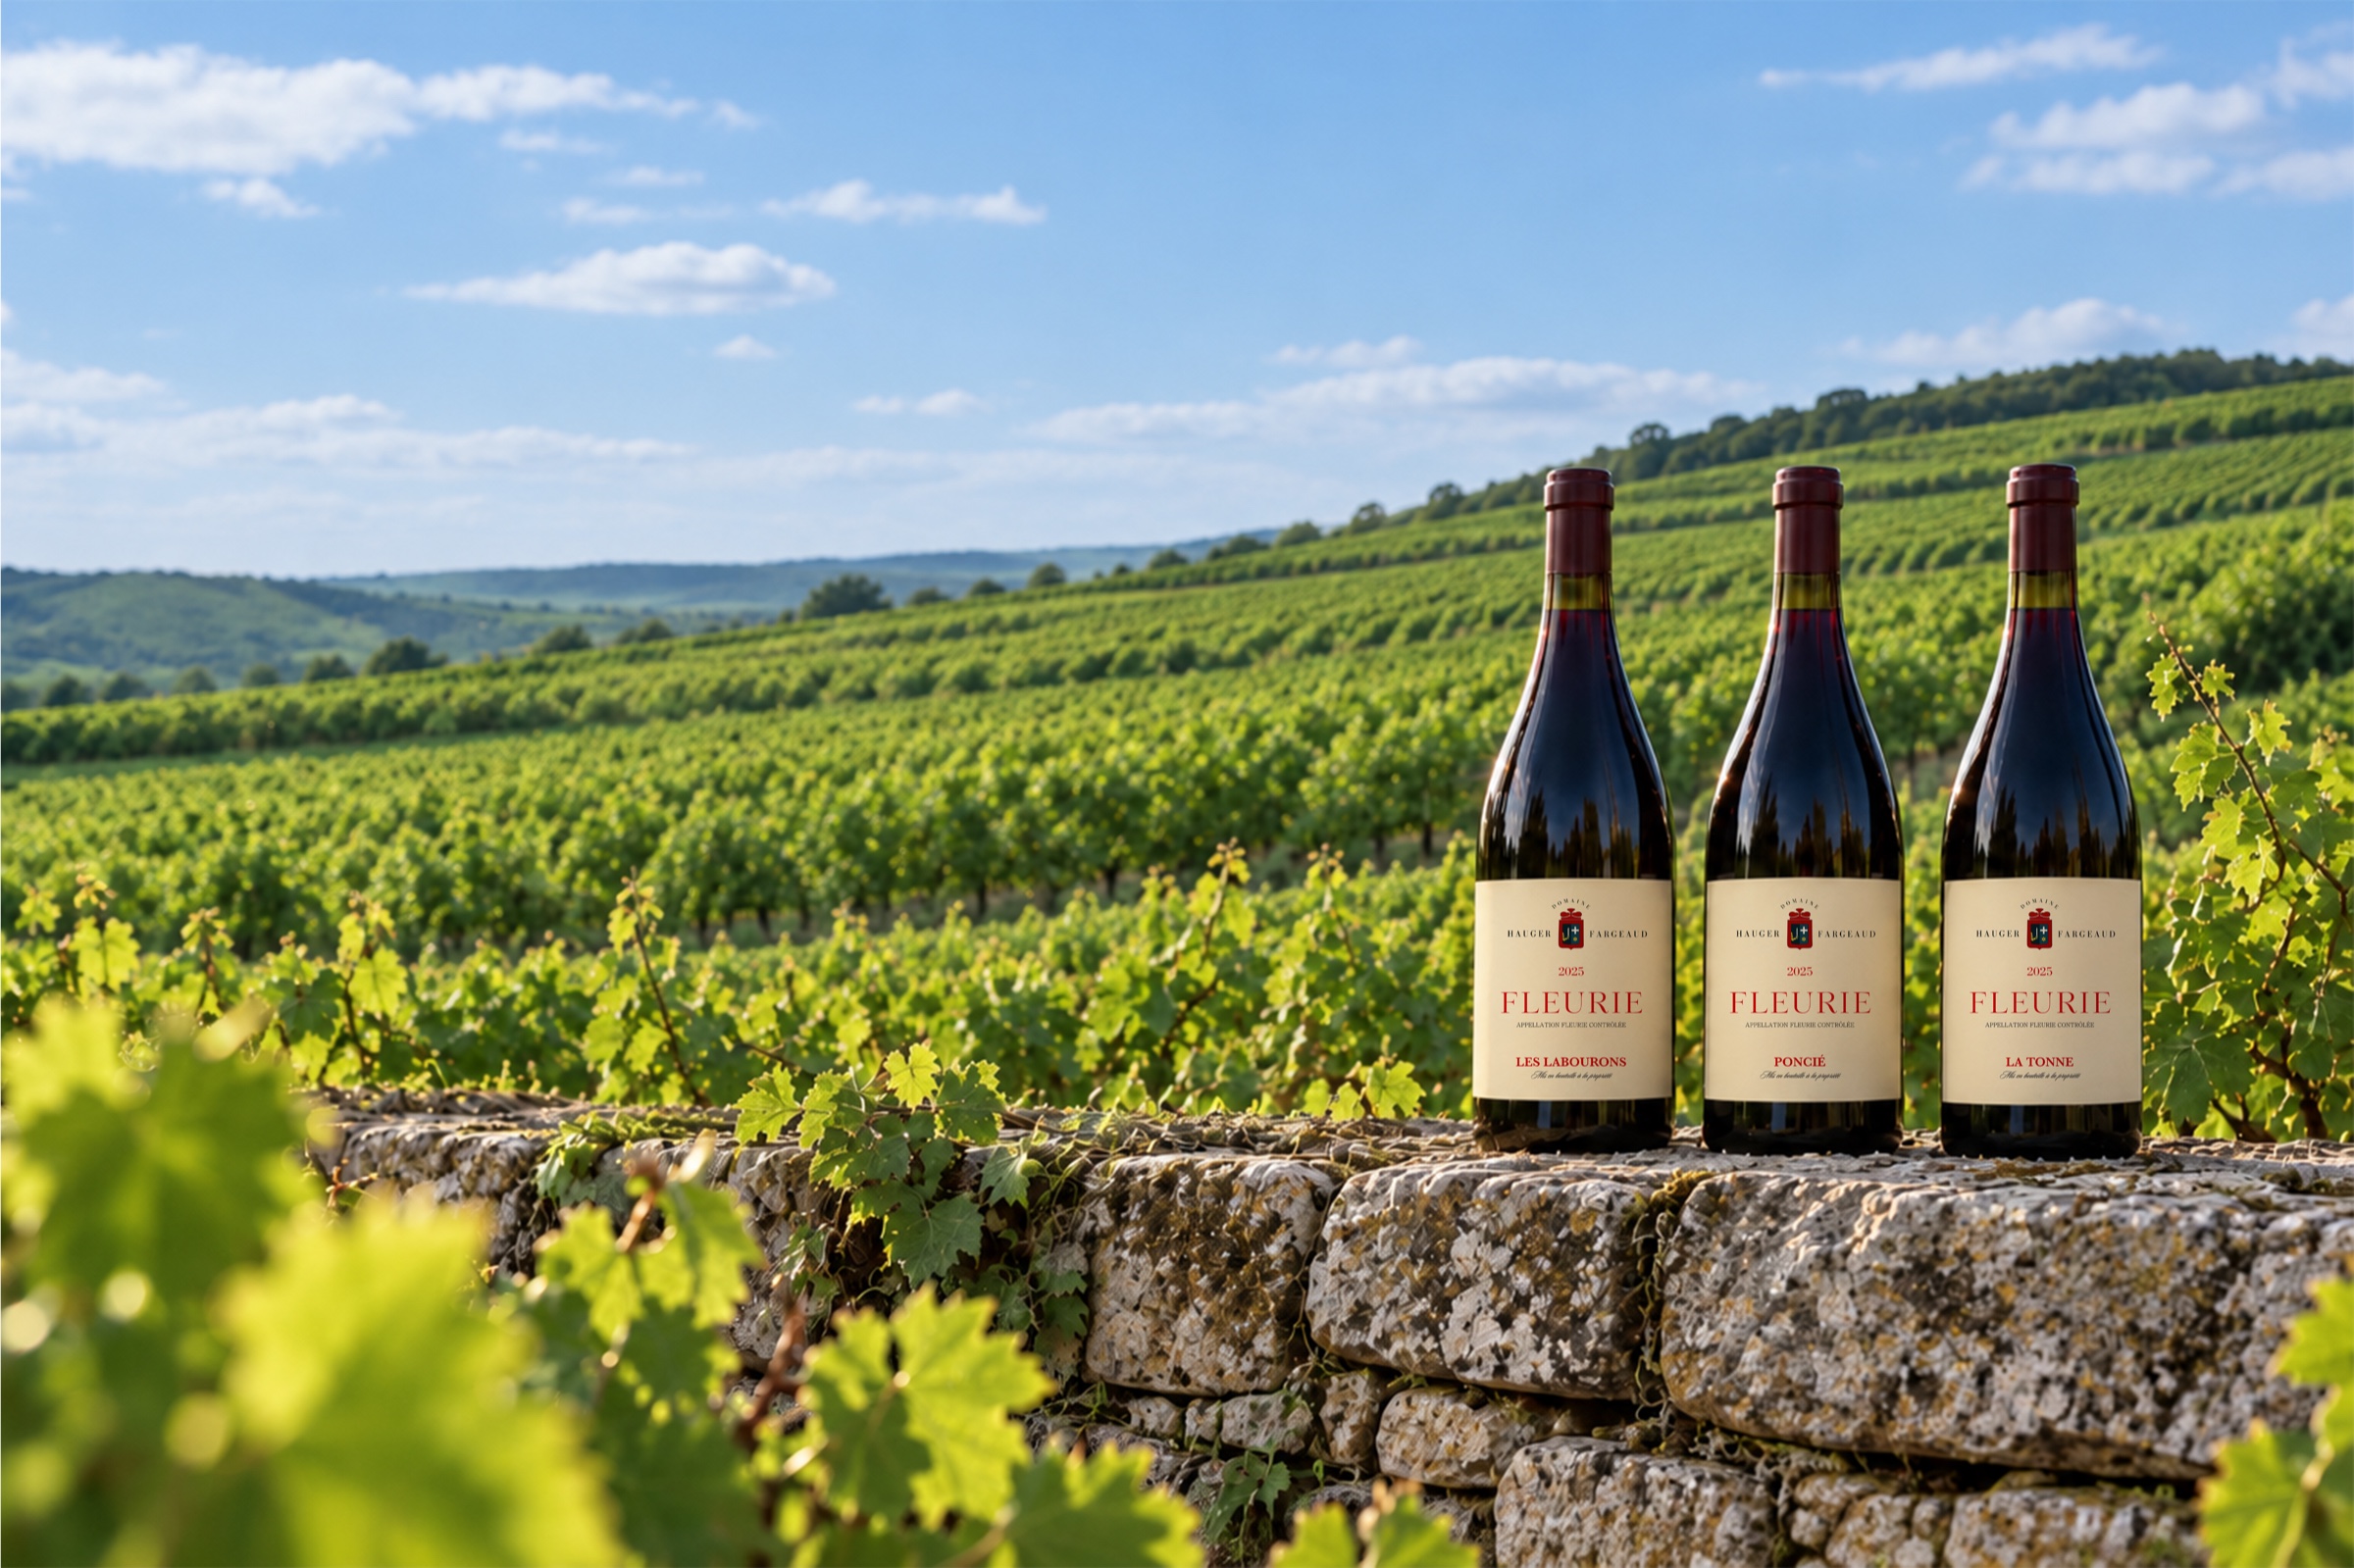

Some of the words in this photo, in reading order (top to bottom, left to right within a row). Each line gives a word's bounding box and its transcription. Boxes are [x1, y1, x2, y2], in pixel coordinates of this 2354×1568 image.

[1552, 898, 1591, 909] DOMAINE
[1780, 898, 1819, 909] DOMAINE
[2021, 898, 2060, 909] DOMAINE
[1559, 967, 1584, 977] 2025
[1787, 967, 1813, 977] 2025
[2027, 967, 2053, 977] 2025
[1501, 991, 1643, 1014] FLEURIE
[1729, 991, 1871, 1014] FLEURIE
[1970, 991, 2111, 1014] FLEURIE
[1516, 1057, 1540, 1067] LES
[1544, 1057, 1626, 1067] LABOURONS
[1774, 1054, 1825, 1067] PONCIÉ
[2006, 1057, 2022, 1067] LA
[2026, 1057, 2073, 1067] TONNE
